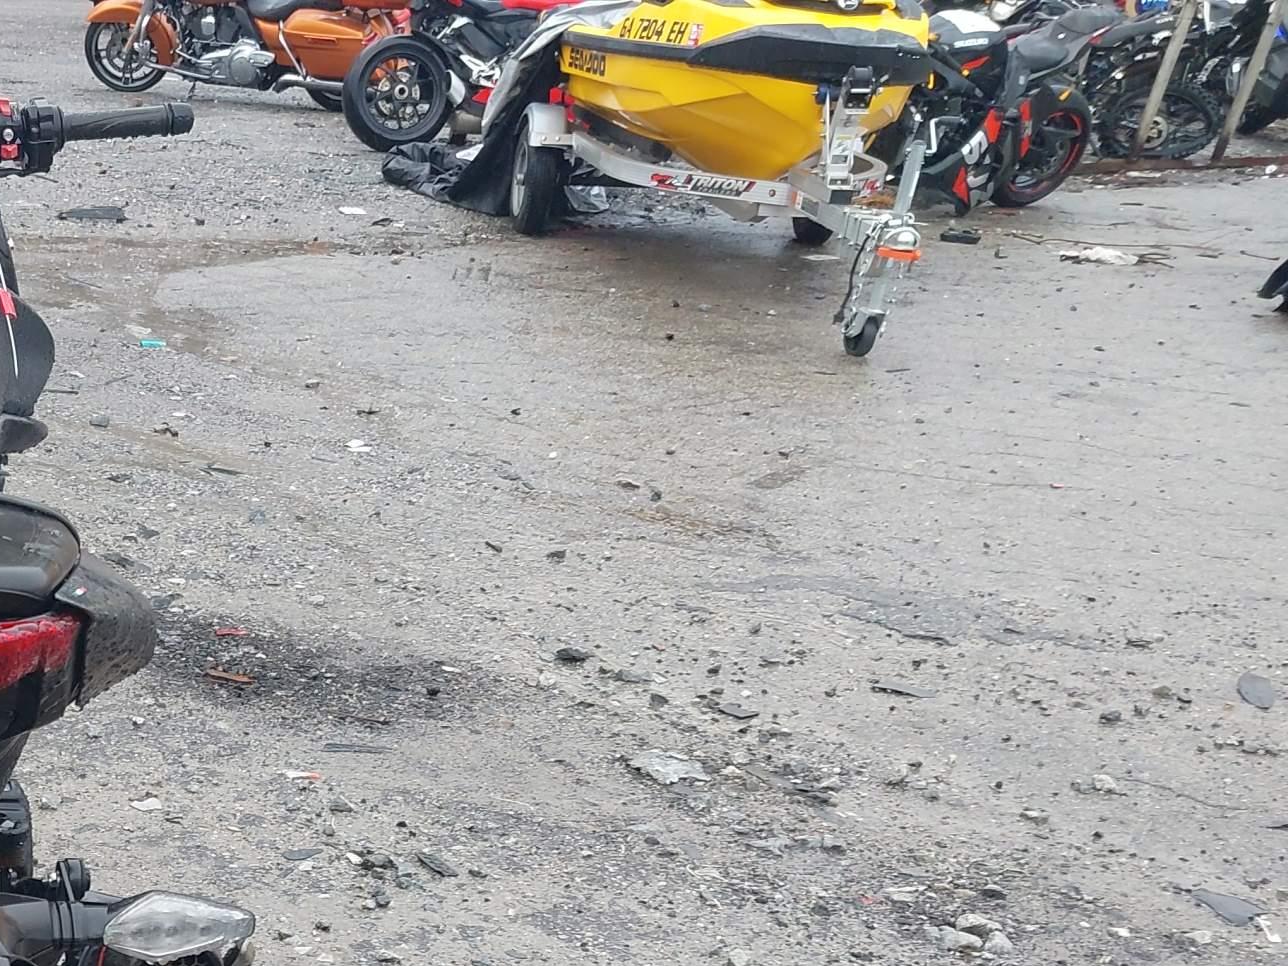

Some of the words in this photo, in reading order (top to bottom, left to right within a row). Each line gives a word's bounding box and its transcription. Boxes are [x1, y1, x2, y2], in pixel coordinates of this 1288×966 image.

[634, 18, 666, 41] 7204
[666, 21, 690, 44] EH
[691, 174, 748, 191] TRITON
